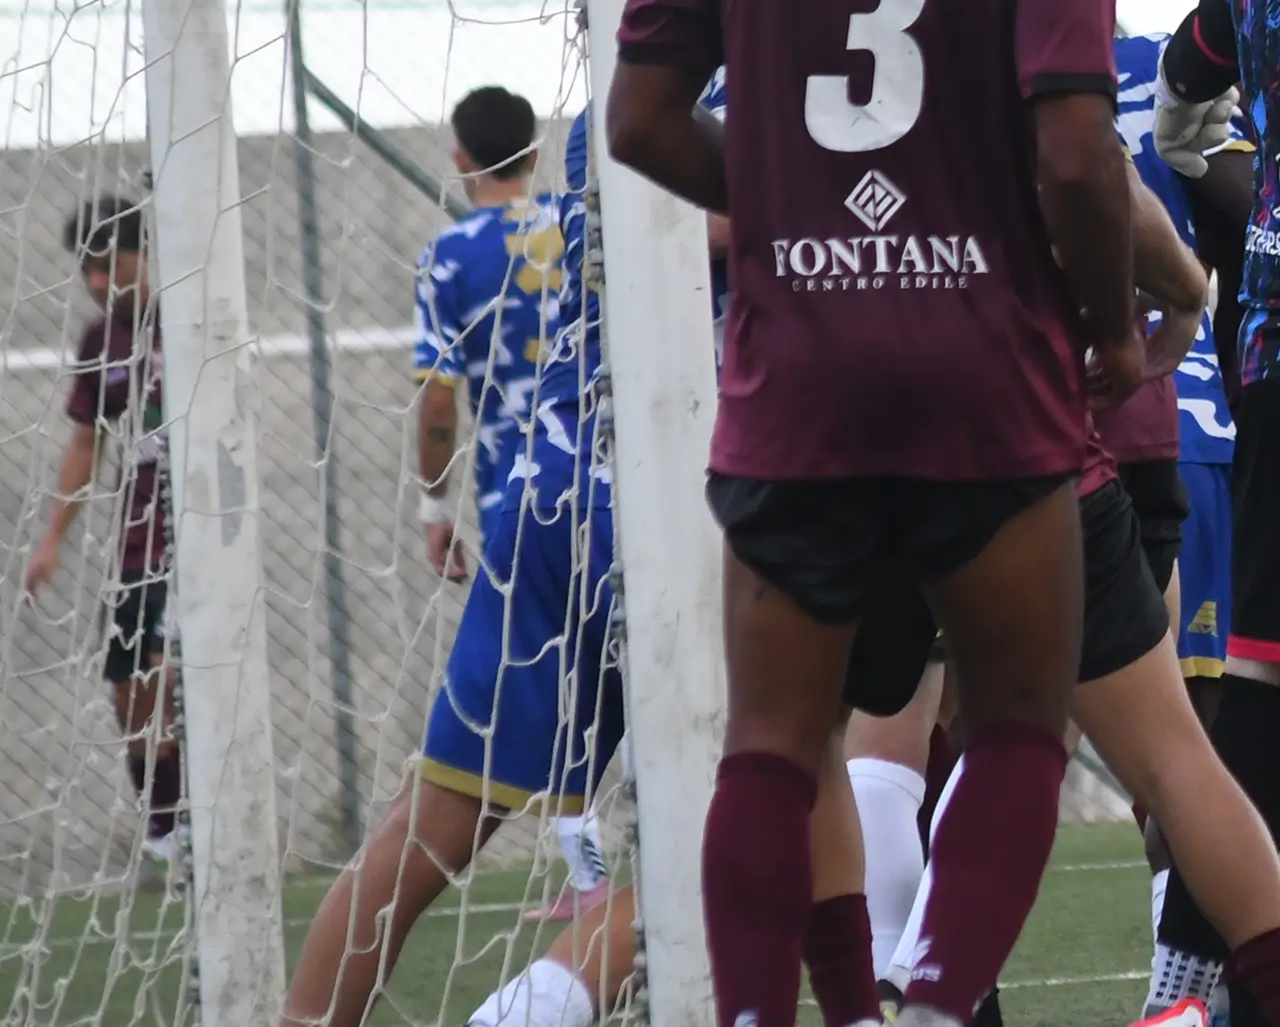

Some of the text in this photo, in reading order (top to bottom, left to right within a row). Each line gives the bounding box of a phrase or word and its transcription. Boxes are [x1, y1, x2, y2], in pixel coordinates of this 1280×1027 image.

[771, 235, 989, 277] FONTANA
[792, 277, 968, 292] CENTRO EDILE
